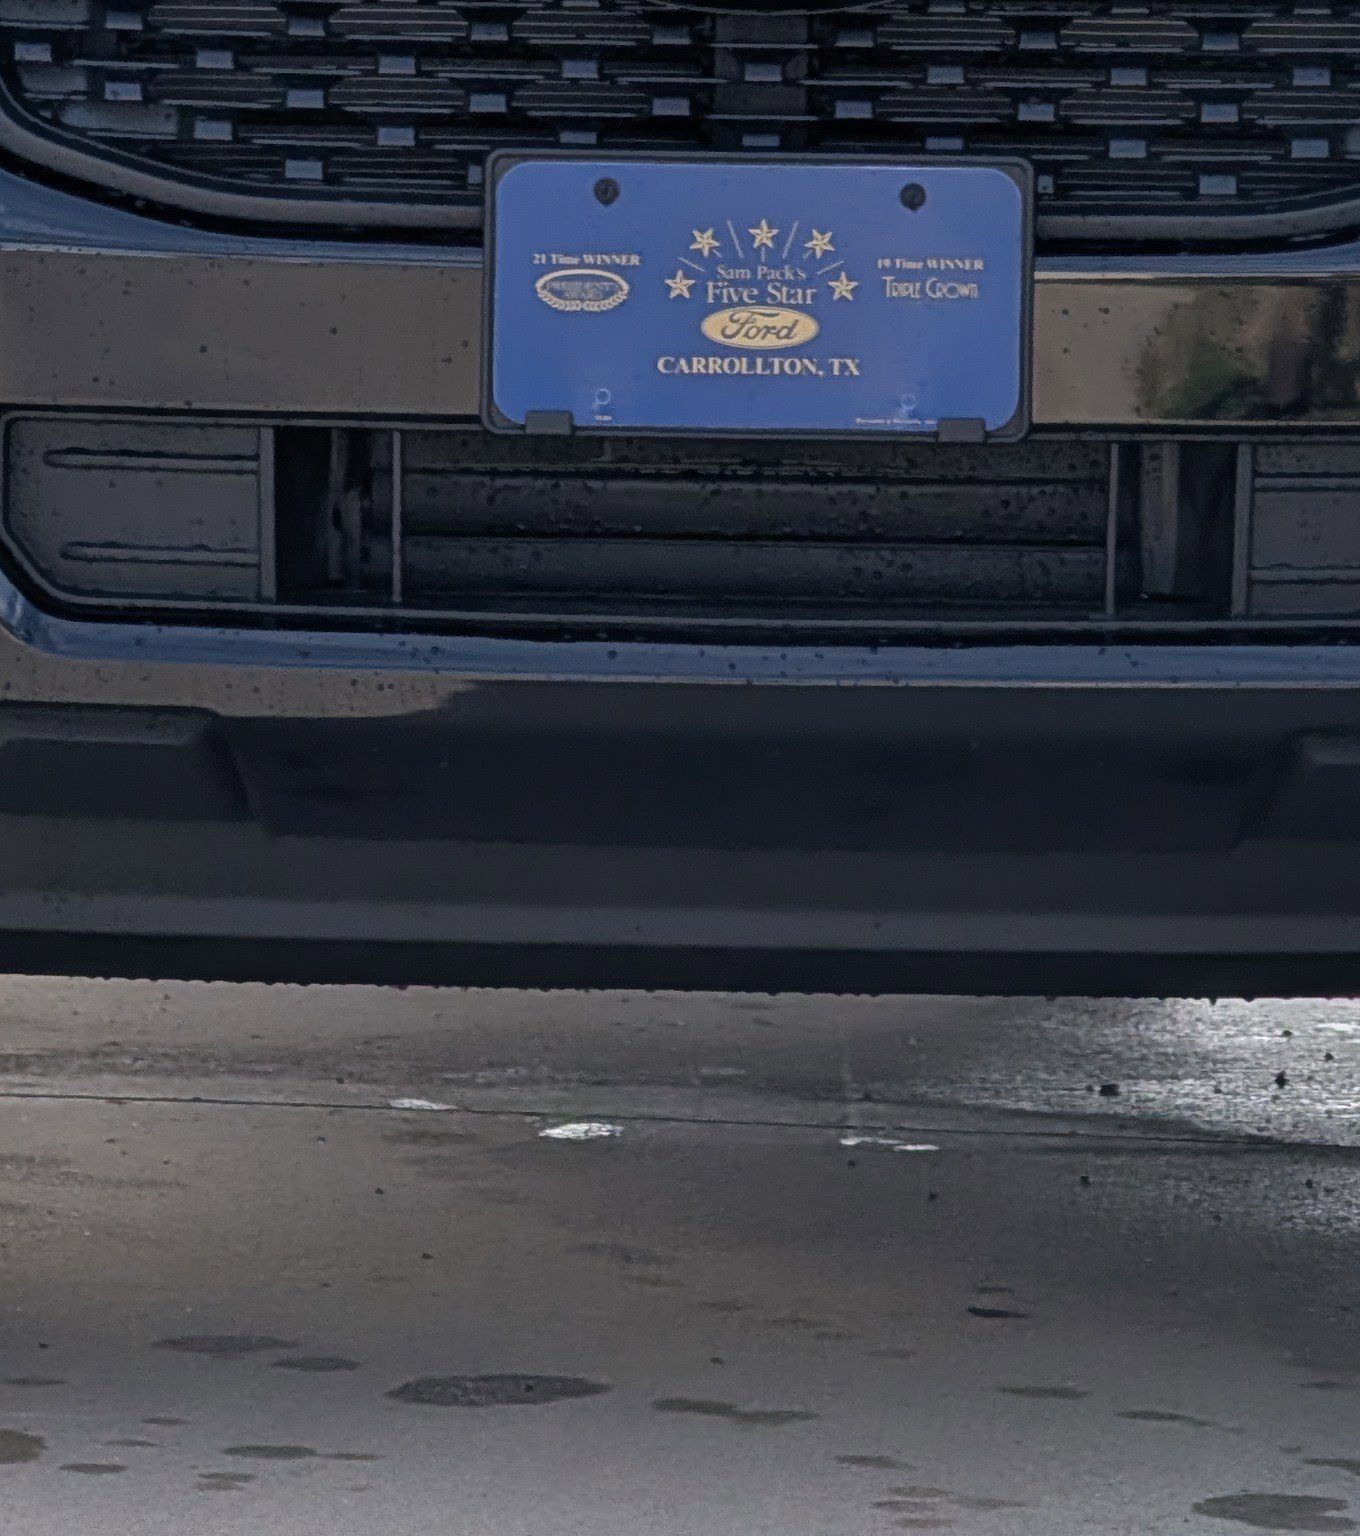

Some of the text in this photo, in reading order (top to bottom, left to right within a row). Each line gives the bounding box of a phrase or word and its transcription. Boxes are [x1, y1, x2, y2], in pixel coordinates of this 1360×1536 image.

[582, 253, 641, 266] WINNER
[925, 258, 985, 271] WINNER
[716, 264, 808, 281] Sam Pack's
[705, 280, 818, 305] Five Star
[720, 309, 800, 341] Ford
[656, 355, 861, 378] CARROLLTON, TX
